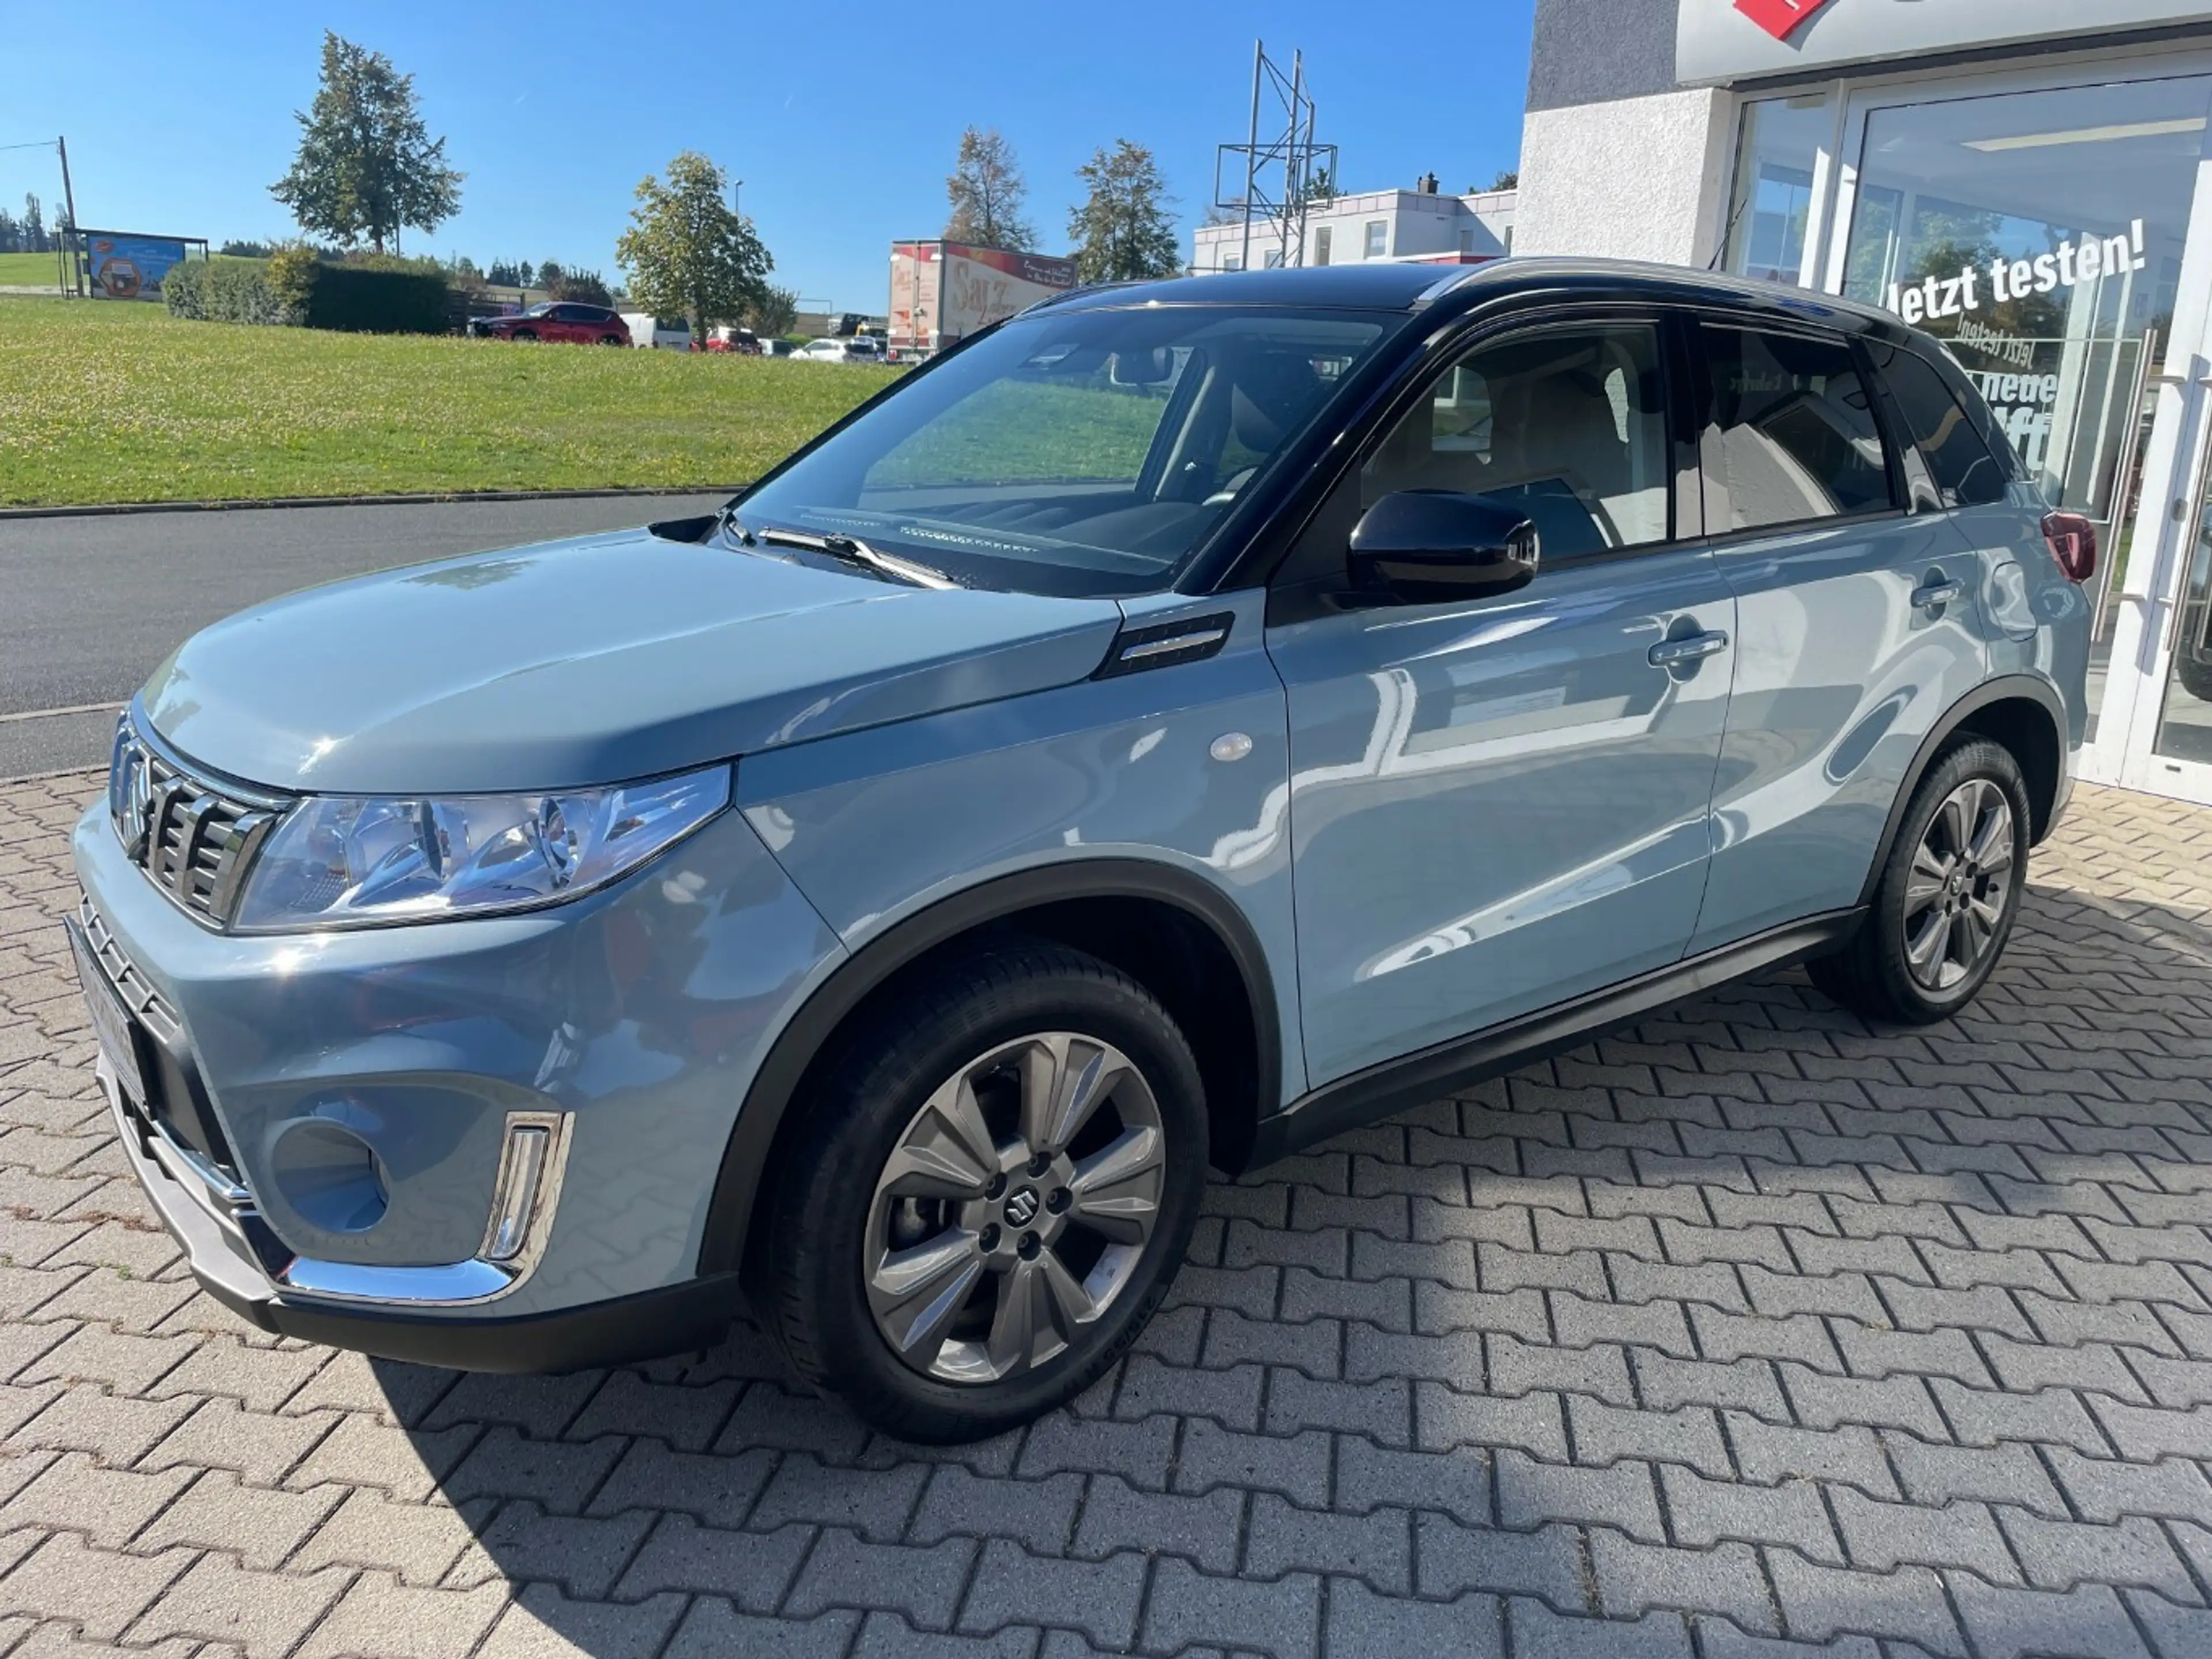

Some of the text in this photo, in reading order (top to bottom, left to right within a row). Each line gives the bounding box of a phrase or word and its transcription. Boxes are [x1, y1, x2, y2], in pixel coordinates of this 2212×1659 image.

[1886, 219, 2145, 324] Jetzt testen!
[1980, 373, 2058, 403] neue
